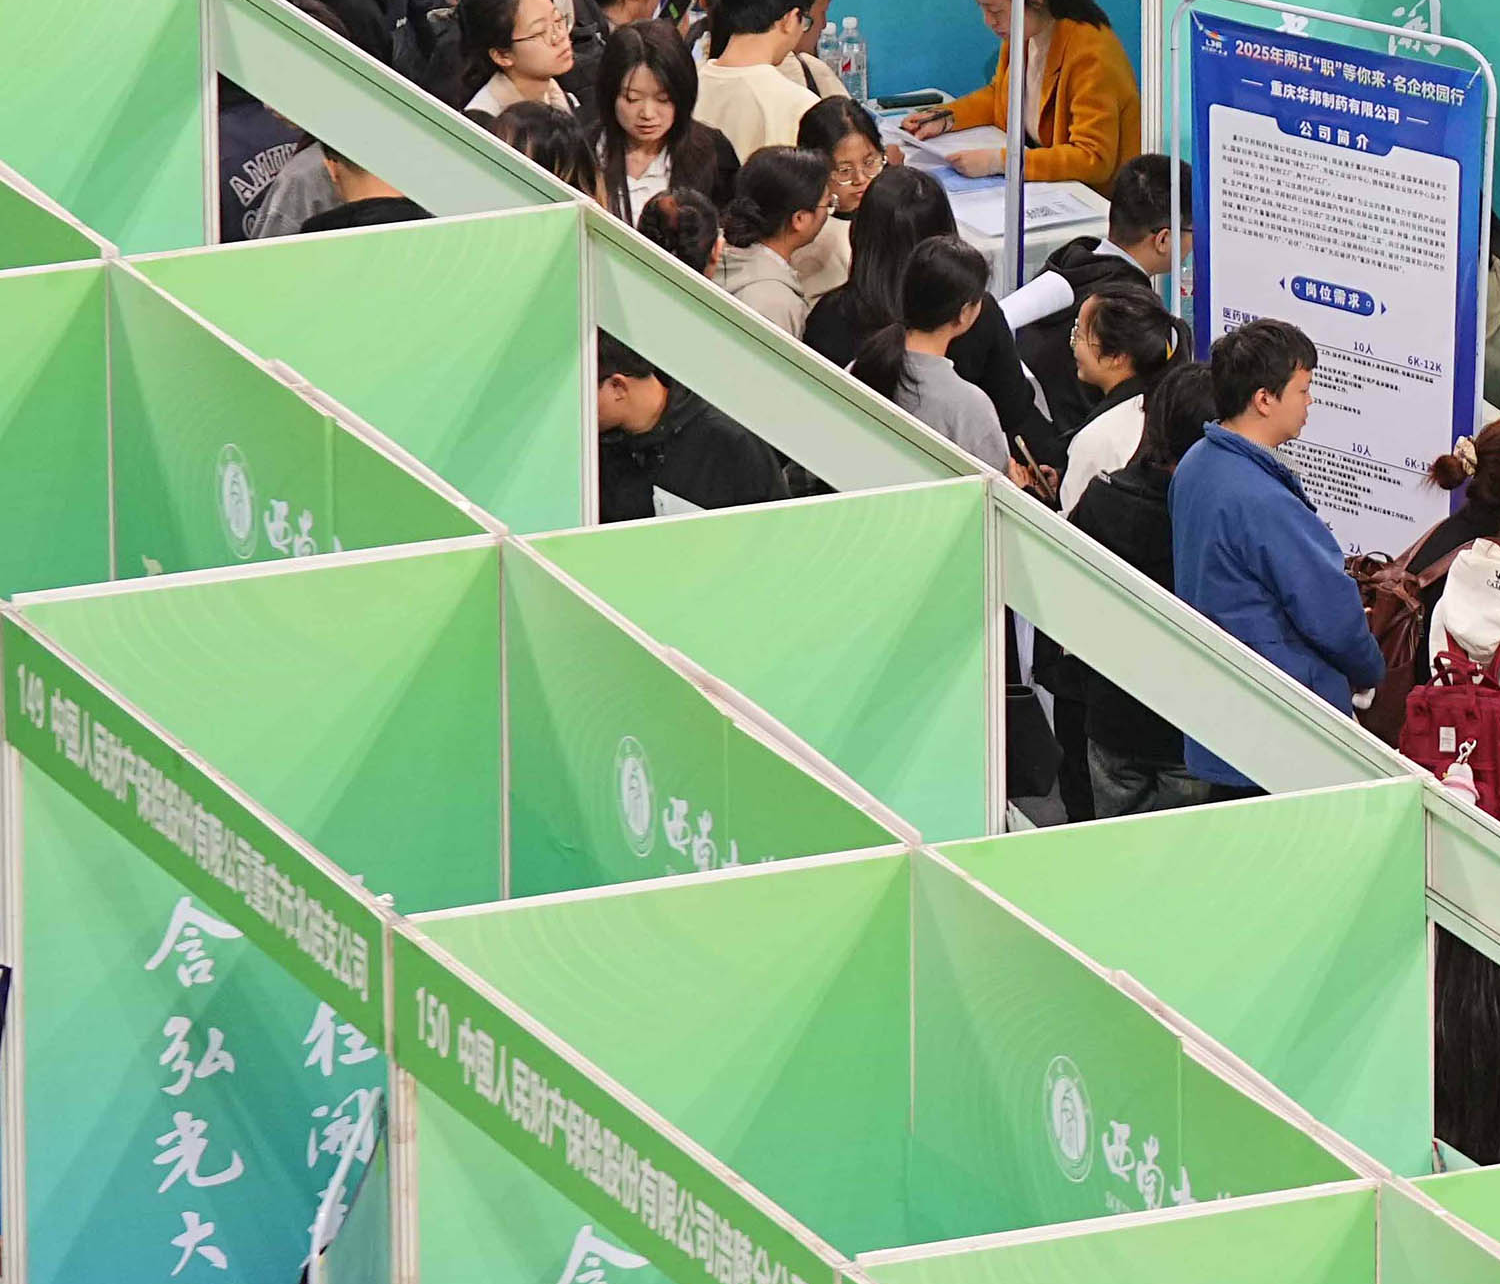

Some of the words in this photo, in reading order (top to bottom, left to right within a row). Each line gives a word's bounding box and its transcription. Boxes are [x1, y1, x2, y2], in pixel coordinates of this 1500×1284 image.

[1270, 80, 1400, 124] 重庆华邦制药有限公司
[1300, 121, 1369, 150] 公司简介
[1305, 281, 1360, 308] 岗位需求
[1353, 341, 1374, 356] 10人
[1408, 355, 1442, 373] 6K-12K
[1352, 442, 1372, 457] 10人
[18, 665, 44, 729] 149
[416, 986, 449, 1053] 150
[145, 897, 244, 1275] 含弘光大
